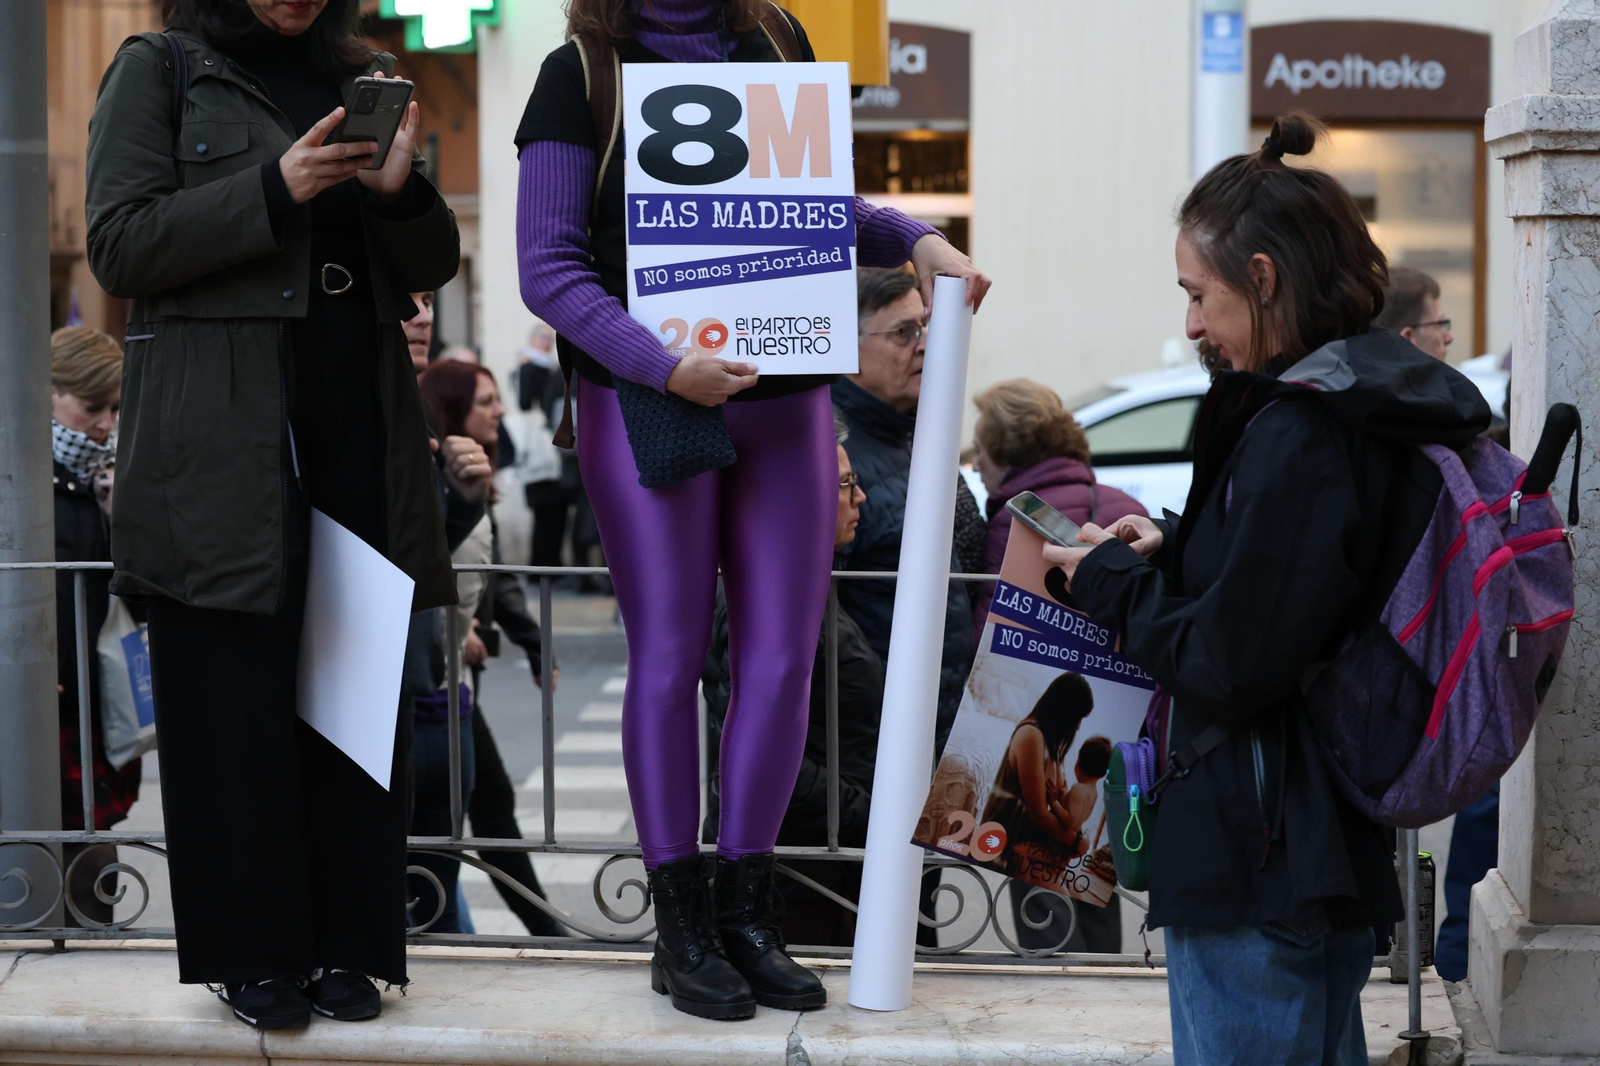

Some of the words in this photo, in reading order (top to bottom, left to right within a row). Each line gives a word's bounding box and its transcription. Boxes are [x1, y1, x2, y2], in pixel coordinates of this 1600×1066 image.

[1263, 52, 1446, 96] Apotheke
[637, 83, 832, 186] 8M
[635, 200, 699, 228] LAS
[711, 201, 848, 230] MADRES
[643, 268, 669, 287] NO
[674, 264, 732, 284] somos
[737, 247, 843, 279] prioridad
[659, 317, 729, 357] 20
[666, 346, 687, 357] ños
[996, 584, 1033, 614] LAS
[1036, 602, 1109, 646] MADRES
[999, 628, 1023, 649] NO
[1027, 638, 1079, 662] somos
[936, 810, 1008, 862] 20
[939, 838, 963, 852] años
